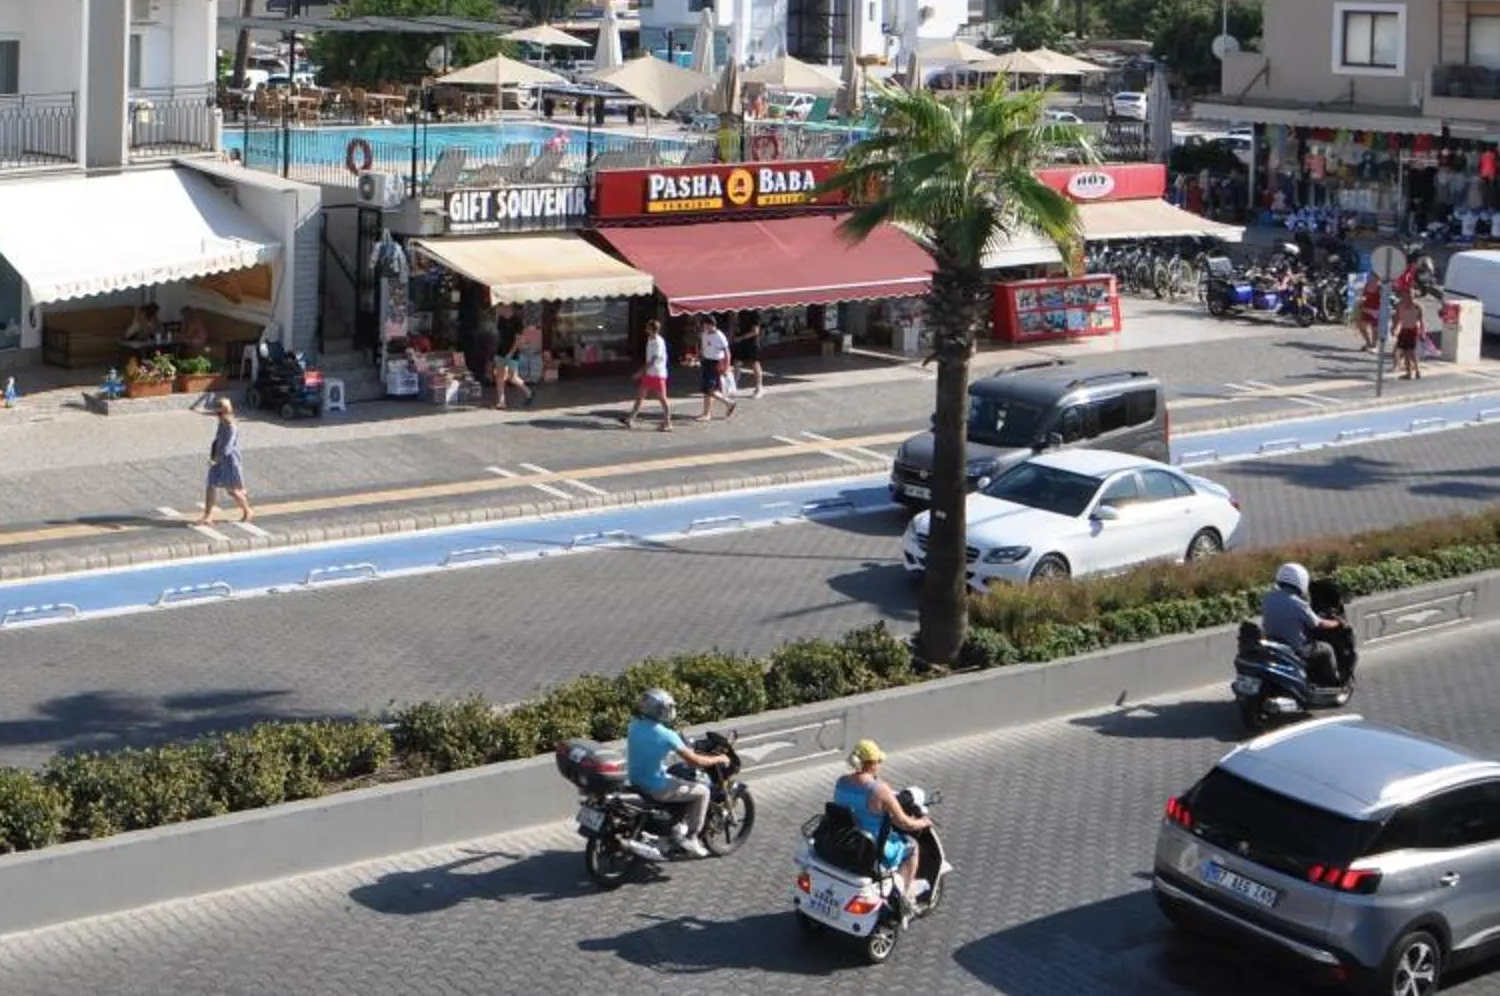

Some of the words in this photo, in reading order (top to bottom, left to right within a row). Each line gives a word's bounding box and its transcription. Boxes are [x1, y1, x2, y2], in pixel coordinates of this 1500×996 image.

[650, 174, 722, 199] PASHA
[759, 168, 816, 193] BABA
[450, 191, 491, 221] GIFT
[496, 187, 587, 218] SOUVENIR
